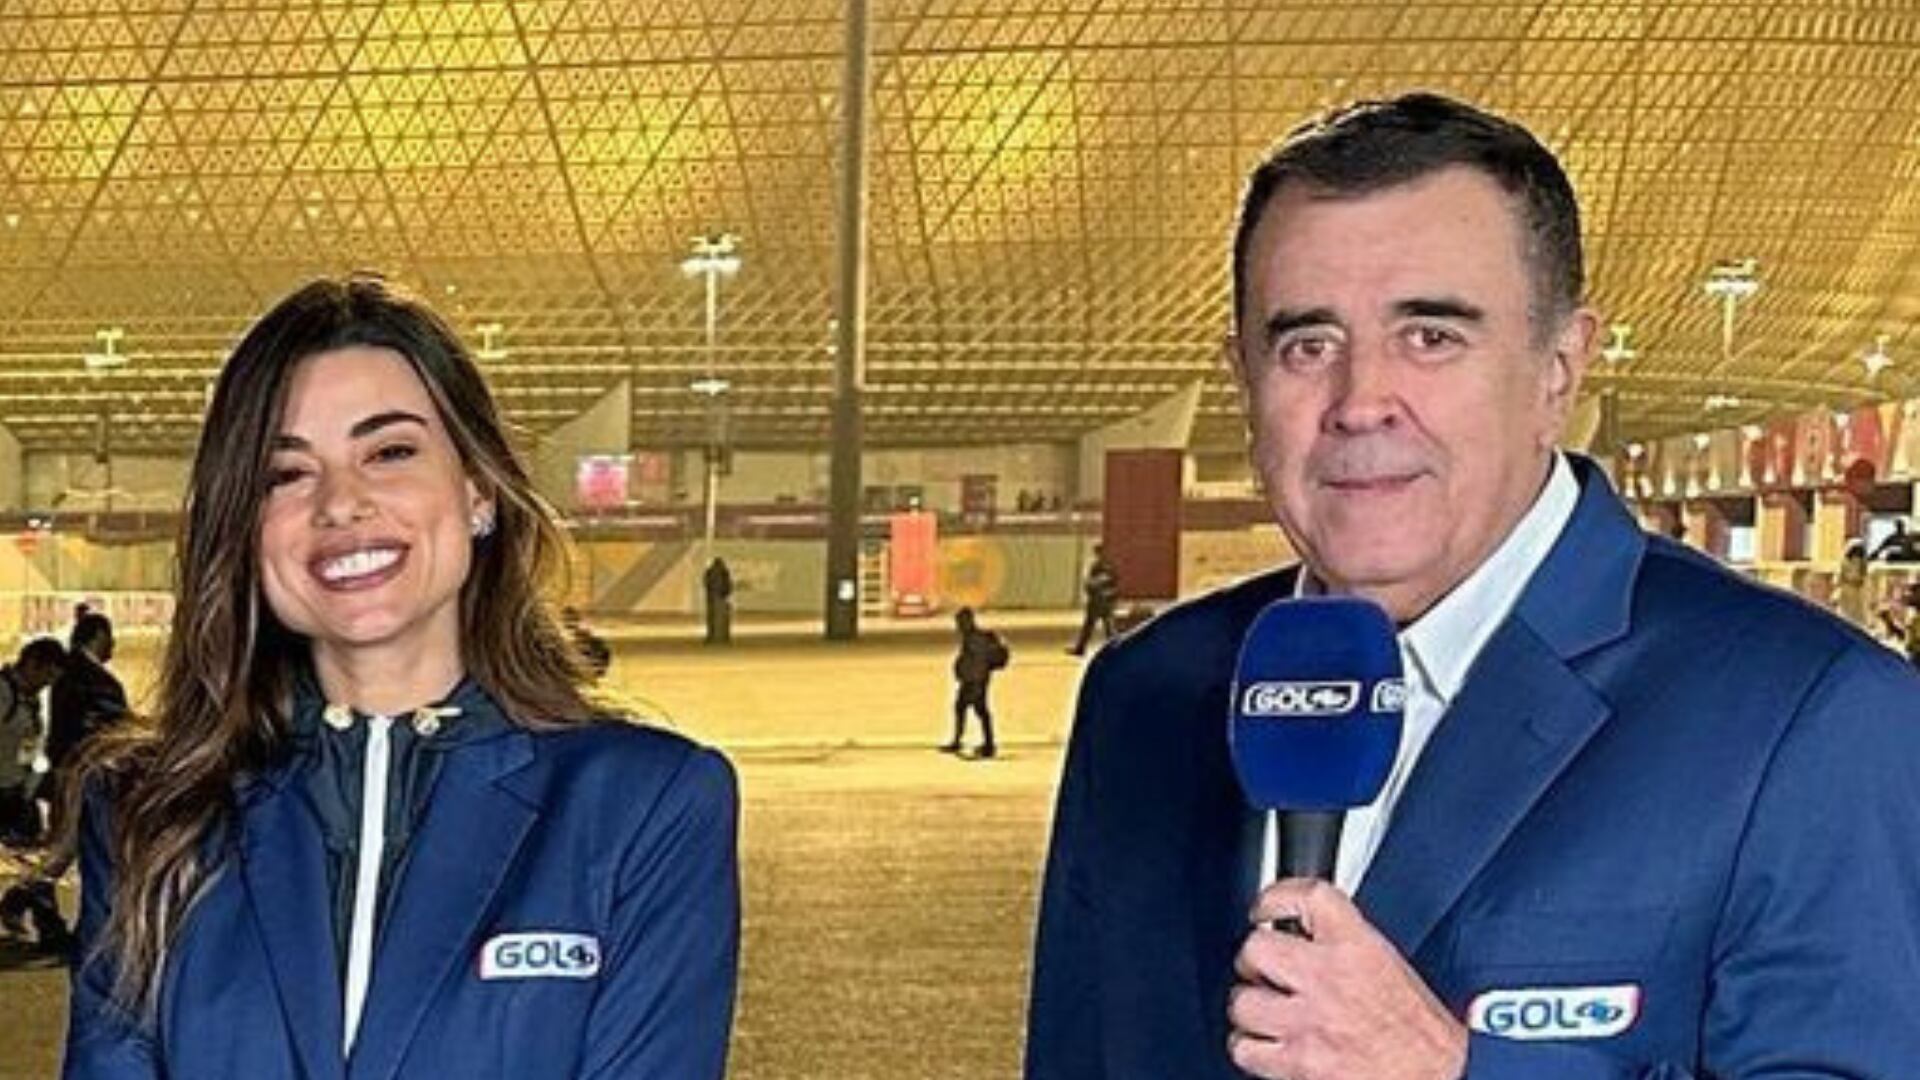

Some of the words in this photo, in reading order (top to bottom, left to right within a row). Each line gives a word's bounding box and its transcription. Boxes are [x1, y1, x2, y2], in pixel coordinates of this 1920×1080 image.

[1255, 687, 1314, 712] GOL
[495, 940, 570, 970] GOL
[1484, 998, 1580, 1033] GOL
